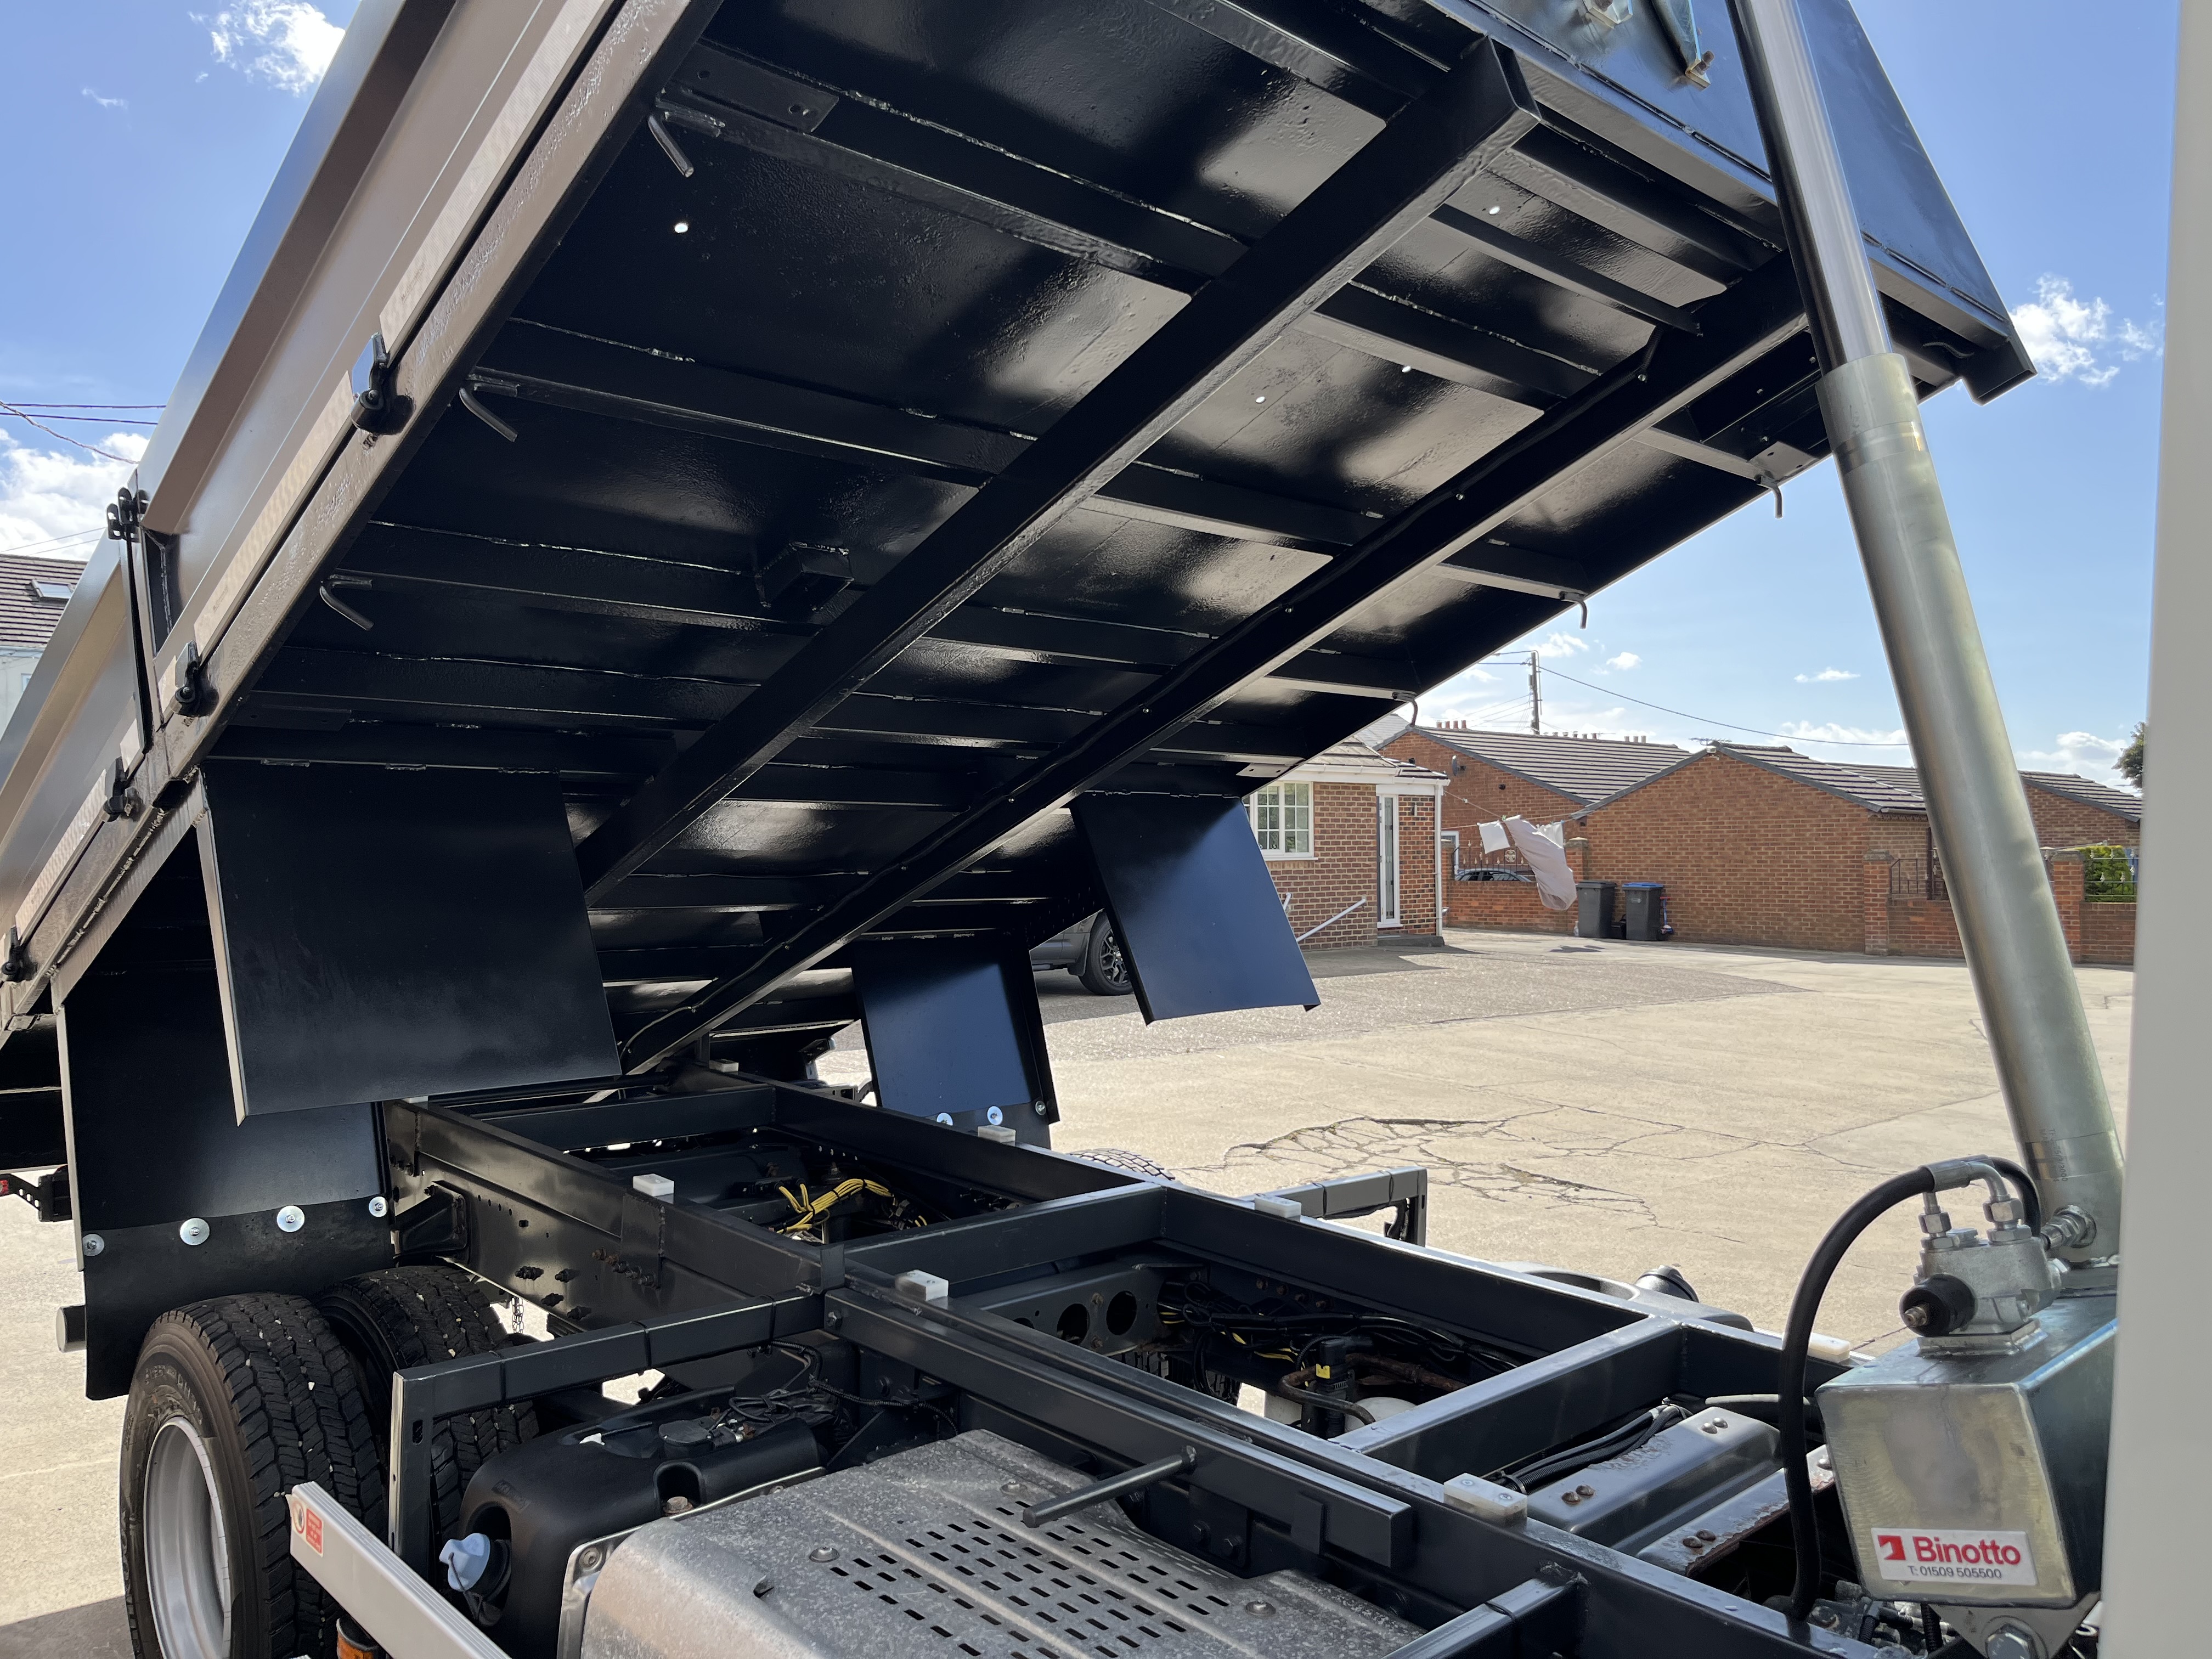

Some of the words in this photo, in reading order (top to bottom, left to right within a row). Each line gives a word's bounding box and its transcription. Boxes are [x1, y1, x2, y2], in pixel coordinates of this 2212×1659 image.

[1912, 1536, 2021, 1565] Binotto
[1908, 1566, 1918, 1576] T:
[1920, 1566, 1954, 1577] 01509
[1956, 1567, 2002, 1578] 505500
